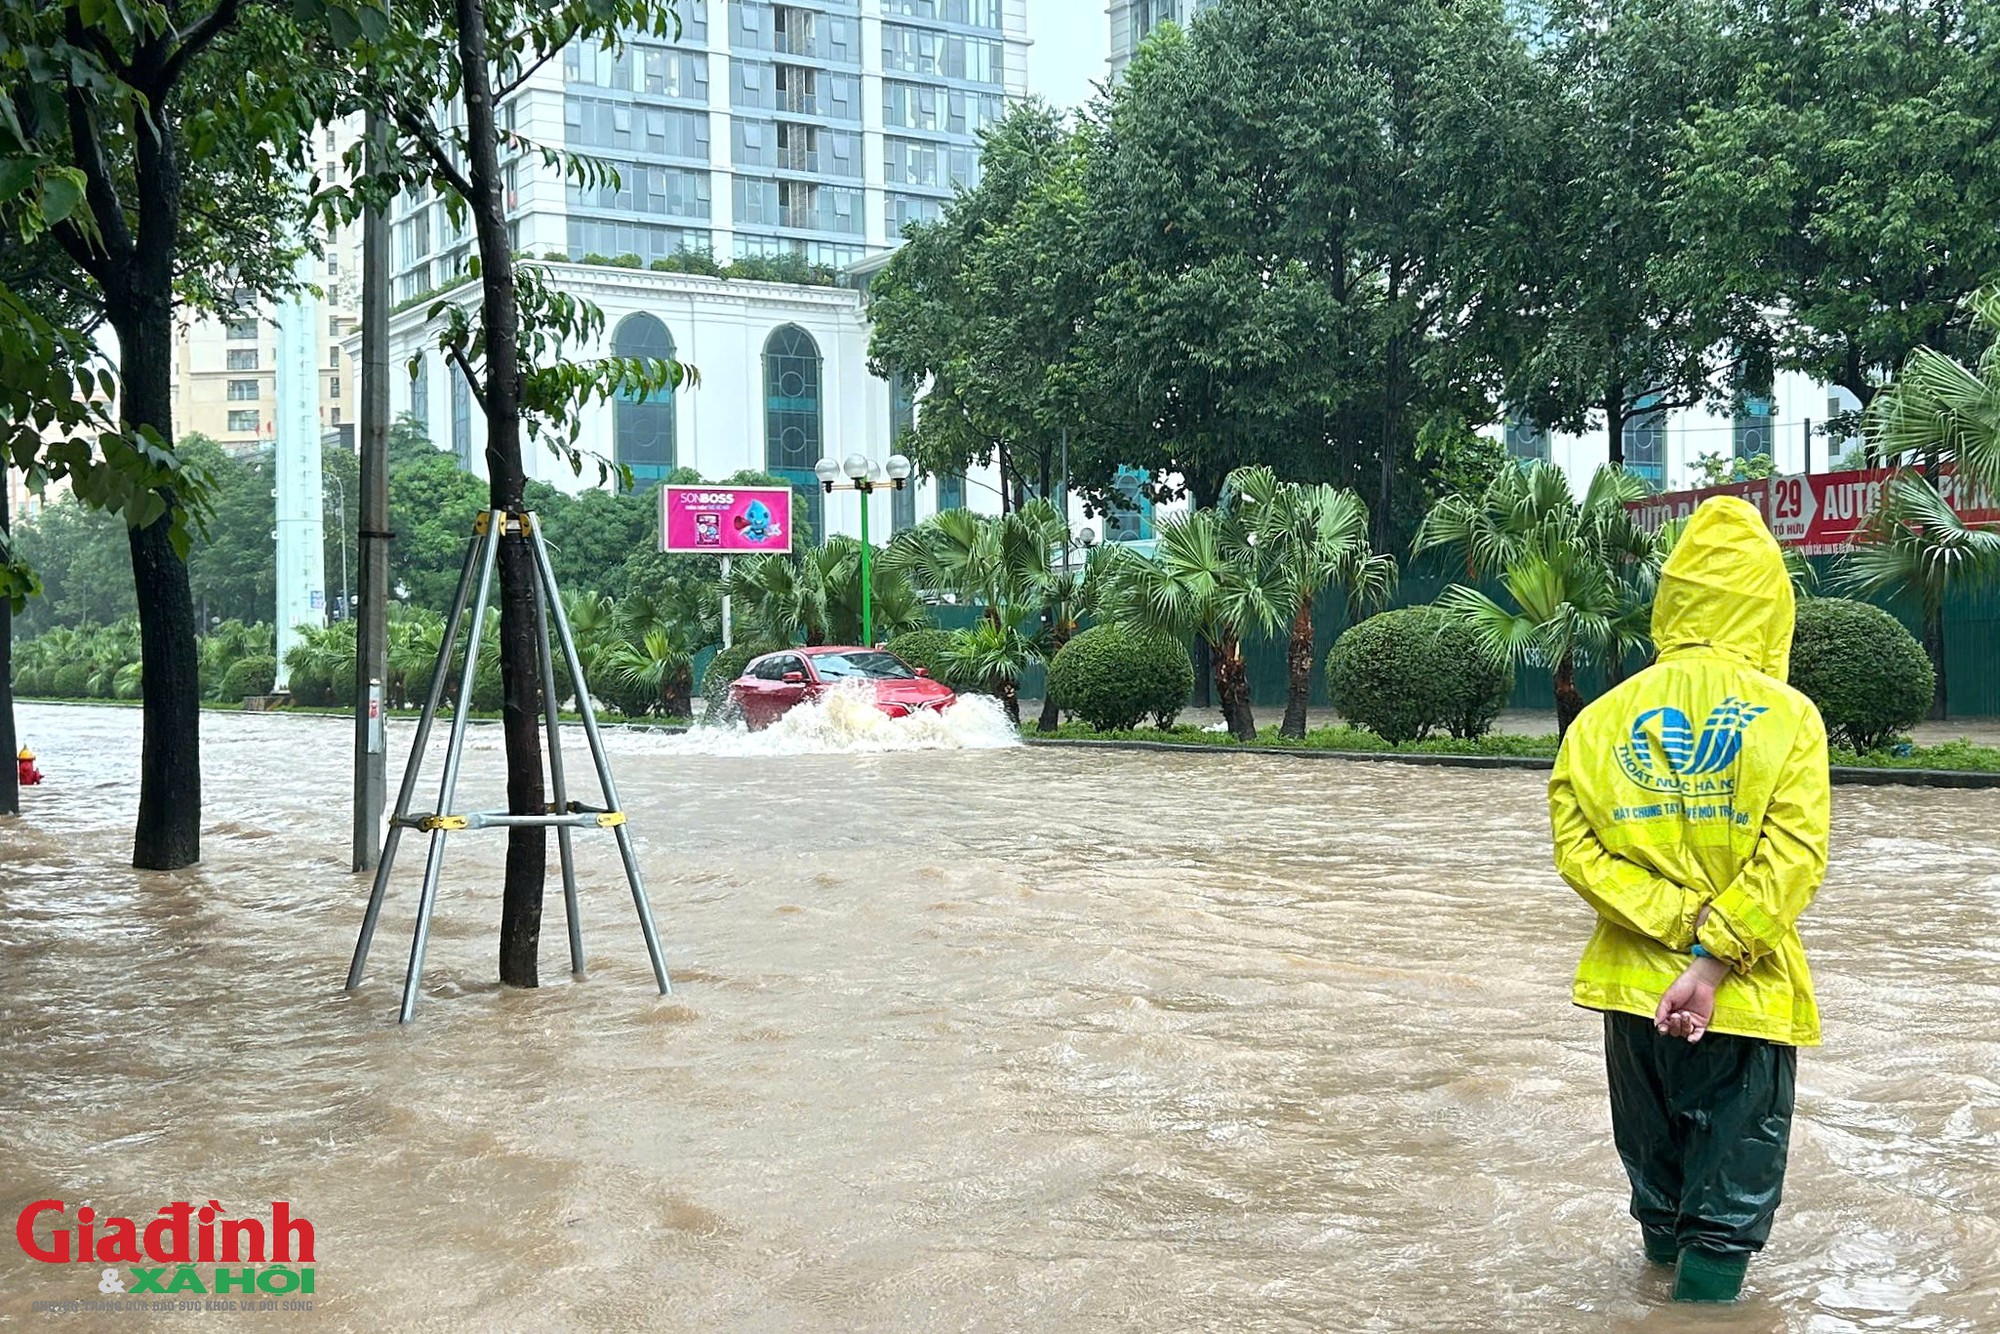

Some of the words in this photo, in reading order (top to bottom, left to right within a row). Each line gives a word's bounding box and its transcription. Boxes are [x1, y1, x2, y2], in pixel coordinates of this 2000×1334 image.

[680, 492, 734, 504] SONBOSS
[1775, 478, 1802, 519] 29
[1823, 480, 1882, 521] AUTO
[1619, 743, 1654, 784] THOÁT
[1632, 804, 1662, 819] CHUNG
[1664, 802, 1680, 815] TAY
